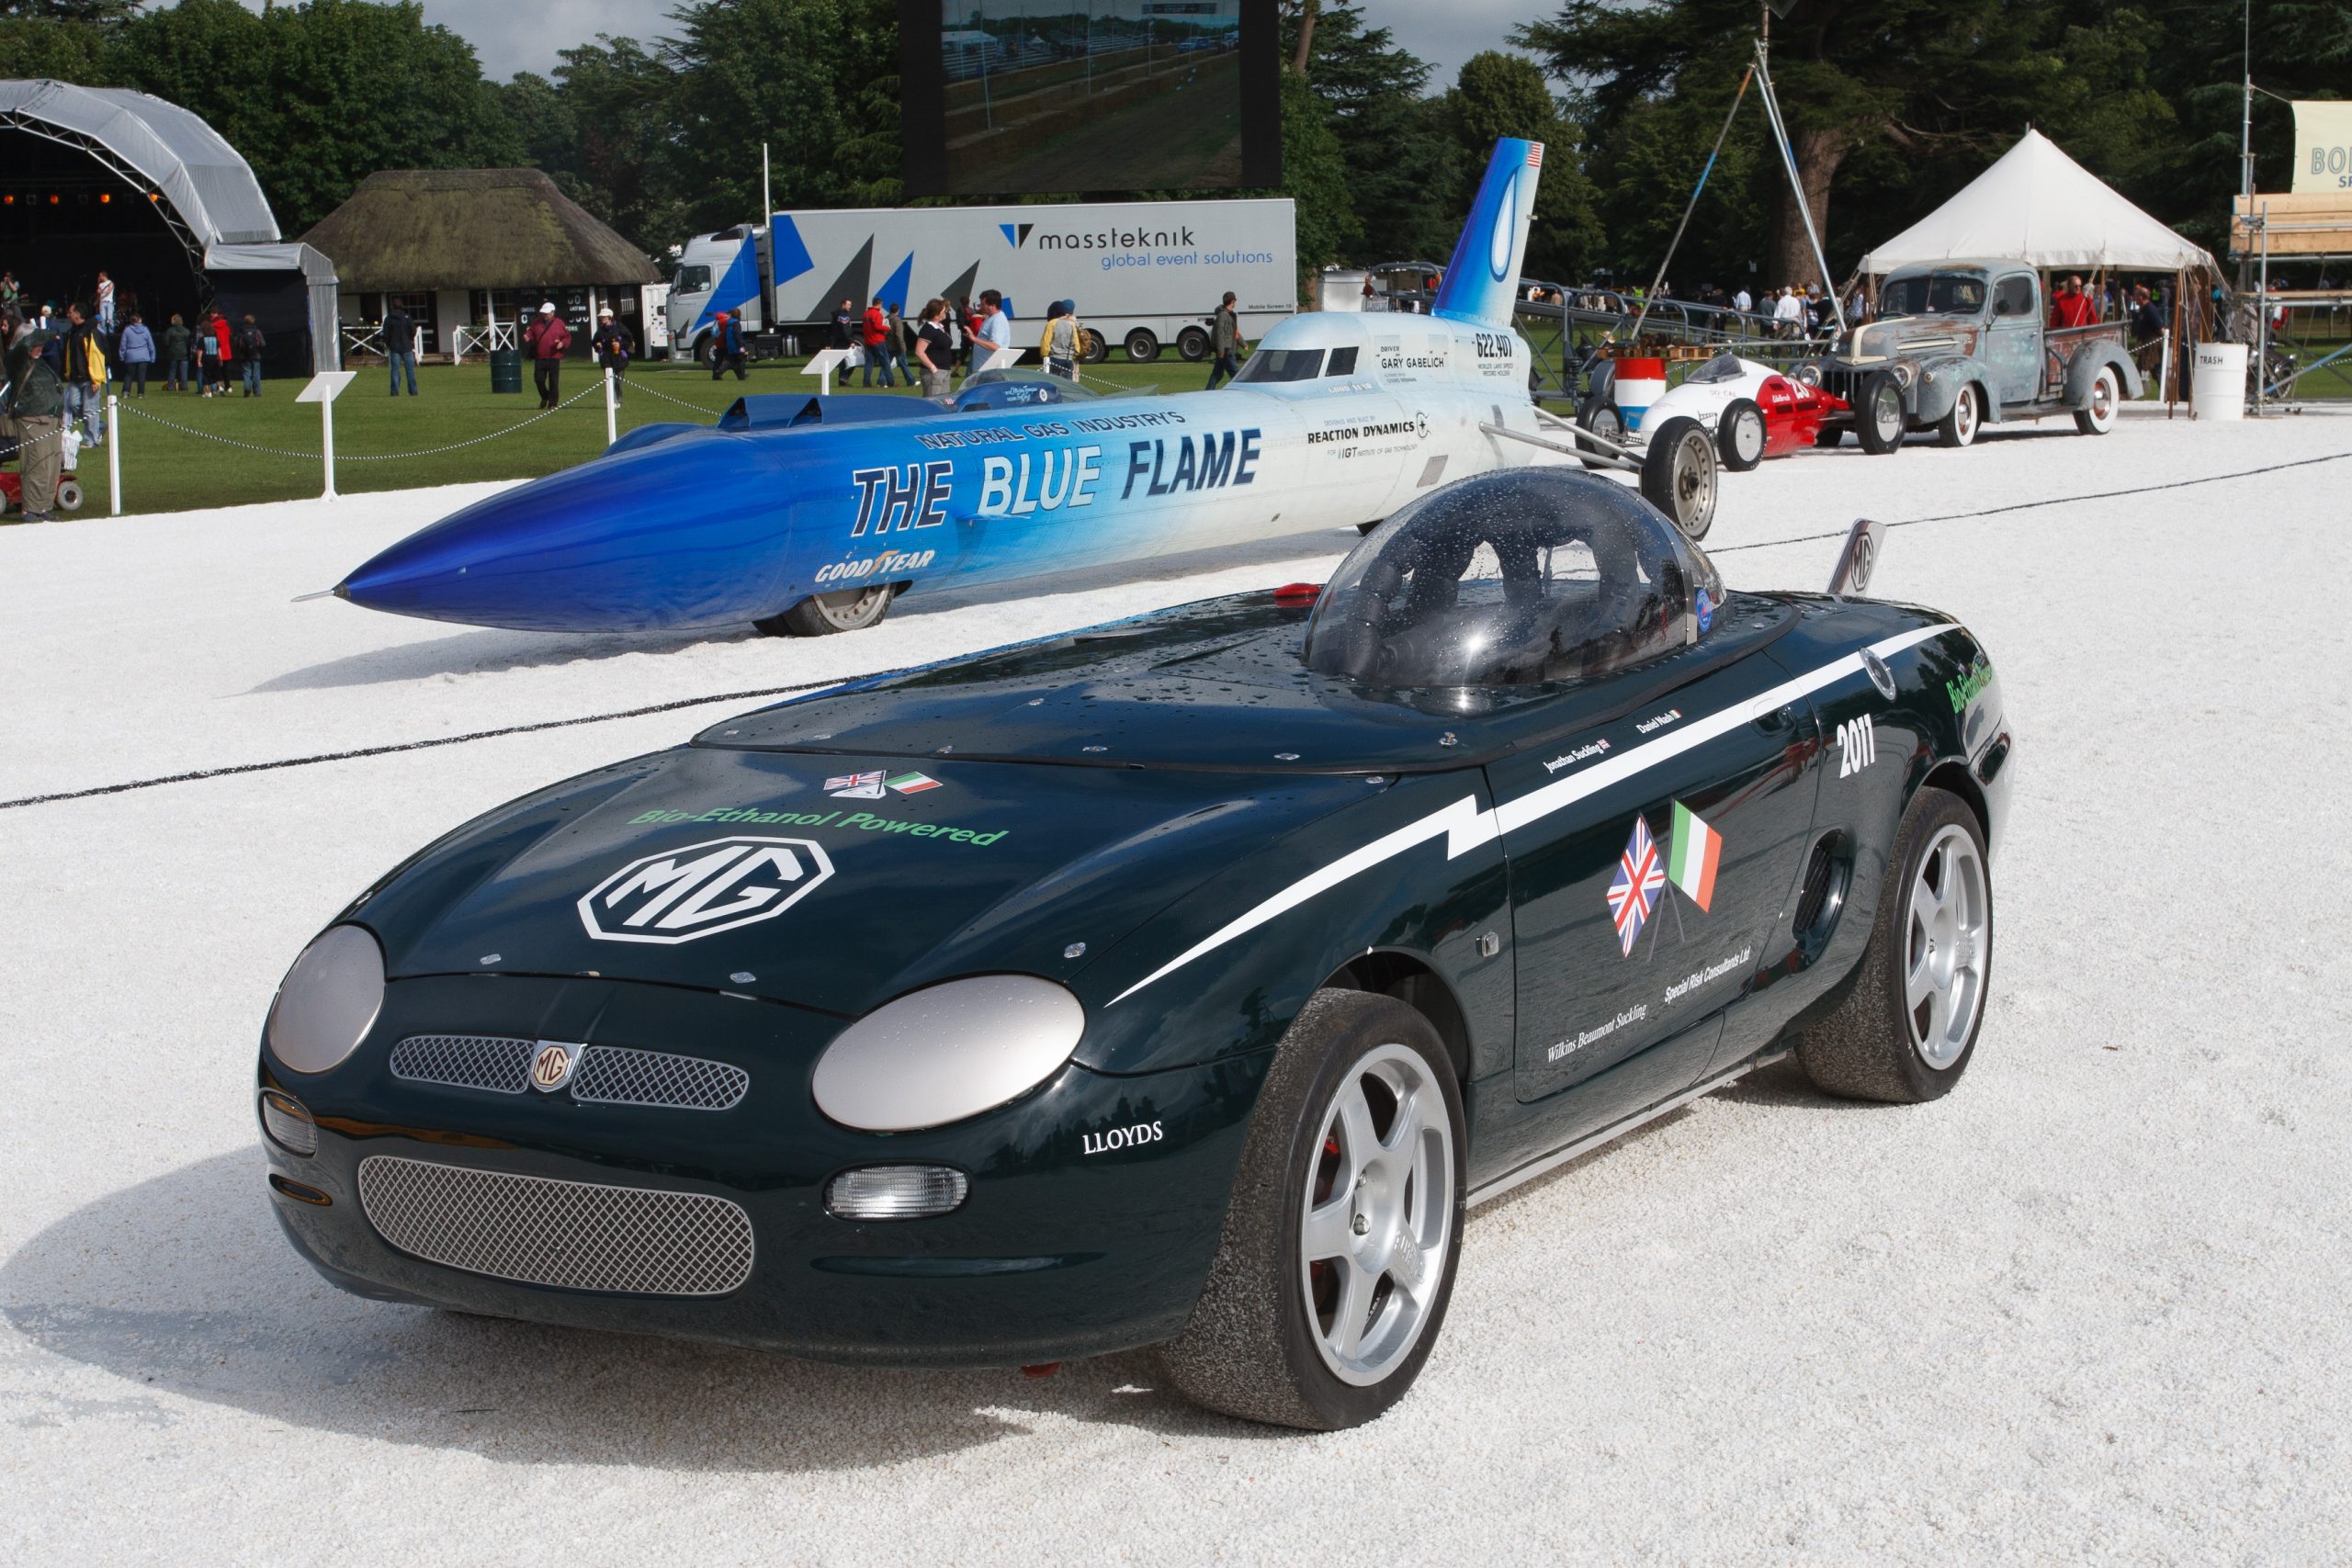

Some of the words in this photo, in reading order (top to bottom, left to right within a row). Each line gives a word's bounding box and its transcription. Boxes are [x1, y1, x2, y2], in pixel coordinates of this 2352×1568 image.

[1039, 225, 1195, 250] massteknik
[1101, 252, 1151, 271] global
[1156, 253, 1198, 265] event
[1204, 250, 1273, 265] solutions
[1476, 332, 1513, 358] 622.407
[2199, 355, 2223, 365] TRASH
[1381, 356, 1404, 369] GARY
[1406, 355, 1445, 368] GABELICH
[916, 426, 1025, 450] NATURAL
[1023, 422, 1071, 438] GAS
[1070, 410, 1187, 434] INDUSTRY'S
[1307, 427, 1359, 444] REACTION
[1363, 421, 1415, 437] DYNAMICS
[1340, 446, 1358, 458] IGT
[851, 460, 953, 537] THE
[977, 445, 1102, 516] BLUE
[1120, 427, 1261, 501] FLAME
[1635, 719, 1660, 734] Daniel
[1543, 755, 1577, 774] Jonathan
[1571, 743, 1605, 761] Suckling
[1836, 713, 1876, 779] 2011
[627, 807, 834, 825] Bio-Ethanol
[834, 810, 1010, 847] Powered
[605, 845, 805, 929] MG
[1664, 976, 1690, 1005] Special
[1689, 970, 1704, 991] Risk
[1703, 953, 1740, 983] Consultants
[1739, 944, 1751, 964] Ltd
[1547, 1039, 1577, 1064] Wilkins
[1577, 1018, 1616, 1049] Beaumont
[1615, 1004, 1647, 1030] Suckling
[1081, 1120, 1163, 1155] LLOYDS
